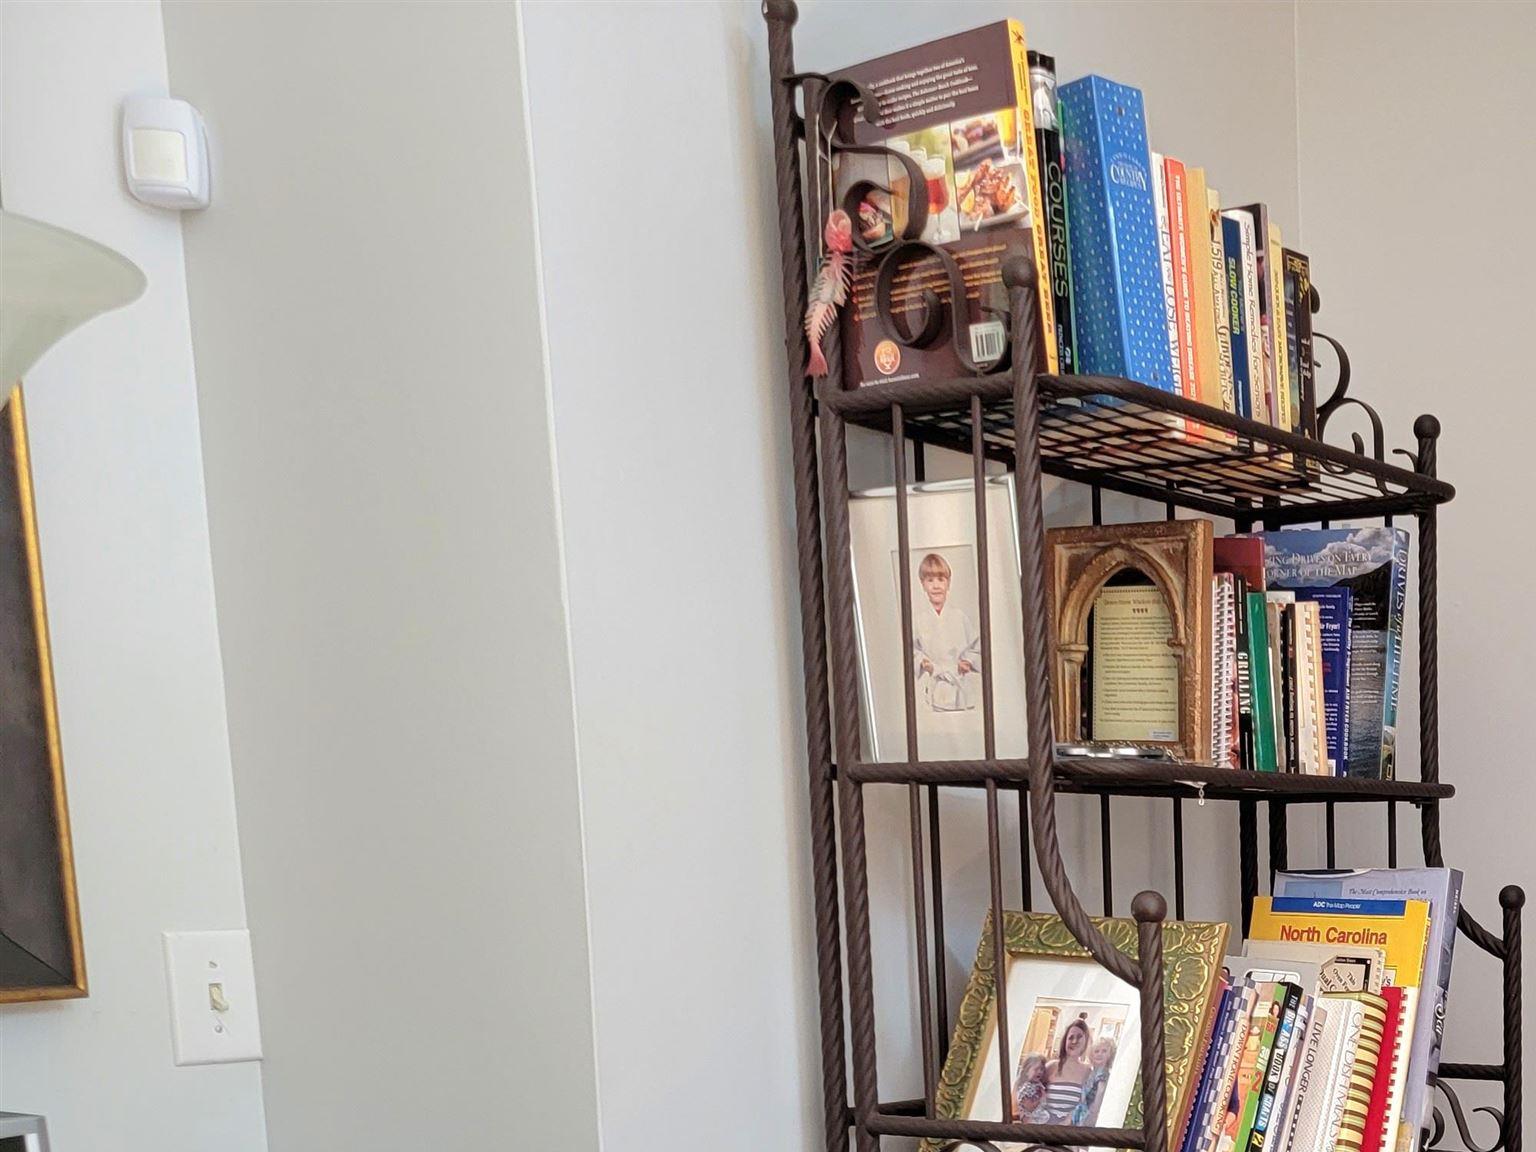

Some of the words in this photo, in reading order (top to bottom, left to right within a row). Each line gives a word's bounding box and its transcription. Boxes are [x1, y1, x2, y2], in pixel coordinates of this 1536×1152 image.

[1049, 161, 1068, 297] COURSES
[1242, 221, 1253, 259] Simple
[1228, 256, 1237, 290] SLOW
[1246, 262, 1255, 296] Home
[1230, 290, 1240, 335] COOKER
[1248, 299, 1260, 353] Remedies
[1252, 354, 1261, 371] for
[1253, 374, 1262, 416] Seniors
[1266, 568, 1298, 577] ORNER
[1315, 567, 1334, 576] THE
[1334, 564, 1359, 576] MAP
[1269, 554, 1289, 565] ING
[1292, 552, 1328, 564] DRIVES
[1328, 552, 1342, 561] ON
[1345, 550, 1372, 562] EVERY
[1394, 549, 1407, 609] DRIVES
[1237, 651, 1251, 715] GRILLING
[1313, 900, 1326, 908] ADC
[1280, 924, 1320, 943] North
[1325, 926, 1388, 946] Carolina
[1282, 1009, 1296, 1027] BIG
[1287, 994, 1298, 1009] THE
[1234, 1023, 1247, 1054] DOWN
[1277, 1028, 1291, 1049] ASS
[1313, 1021, 1323, 1048] LIVE
[1345, 1011, 1363, 1050] ONE
[1226, 1055, 1239, 1083] HOME
[1269, 1051, 1283, 1079] BOOK
[1298, 1048, 1316, 1094] LONGER
[1214, 1083, 1231, 1129] COOKING
[1257, 1093, 1273, 1128] CRAFTS
